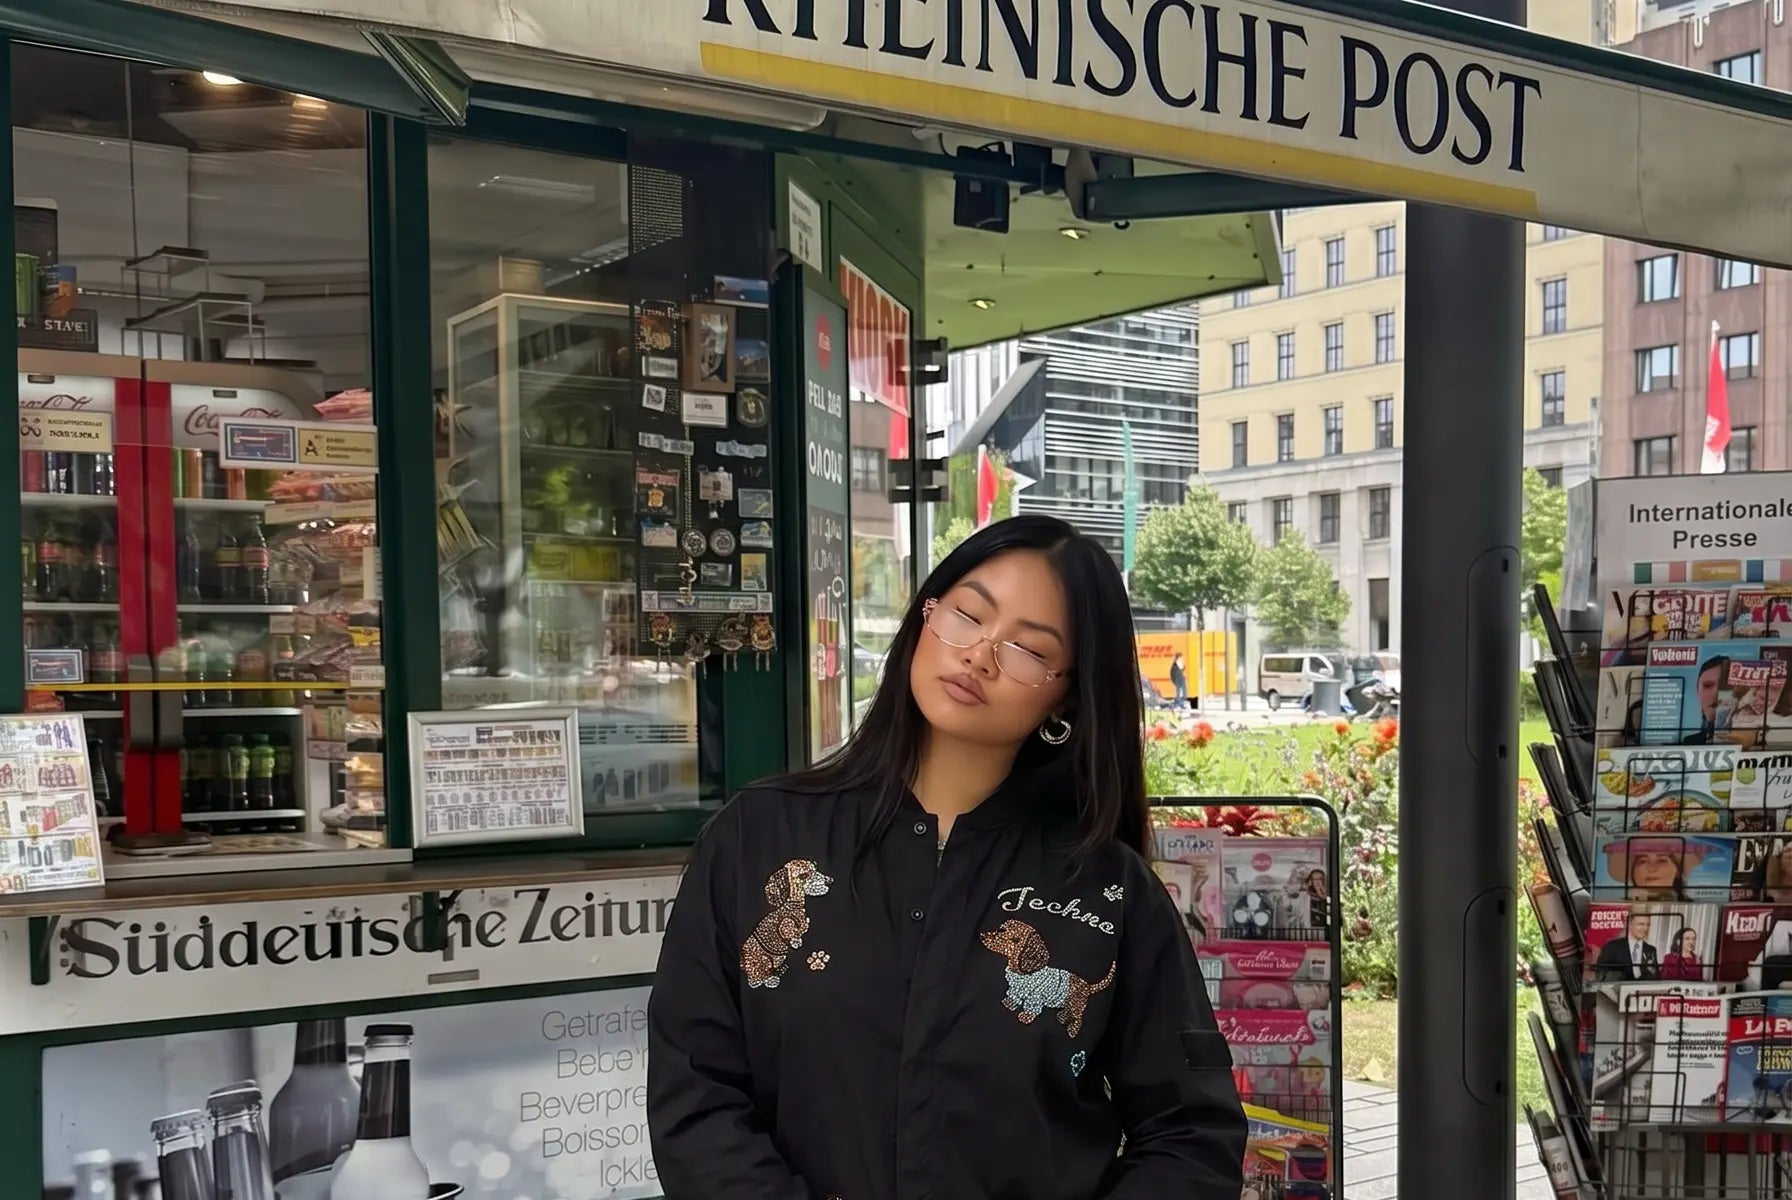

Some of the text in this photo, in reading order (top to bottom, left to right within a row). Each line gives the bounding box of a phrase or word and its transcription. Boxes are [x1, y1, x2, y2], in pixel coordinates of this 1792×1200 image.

[702, 0, 1543, 173] EINISCHE POST
[1673, 530, 1758, 550] Presse
